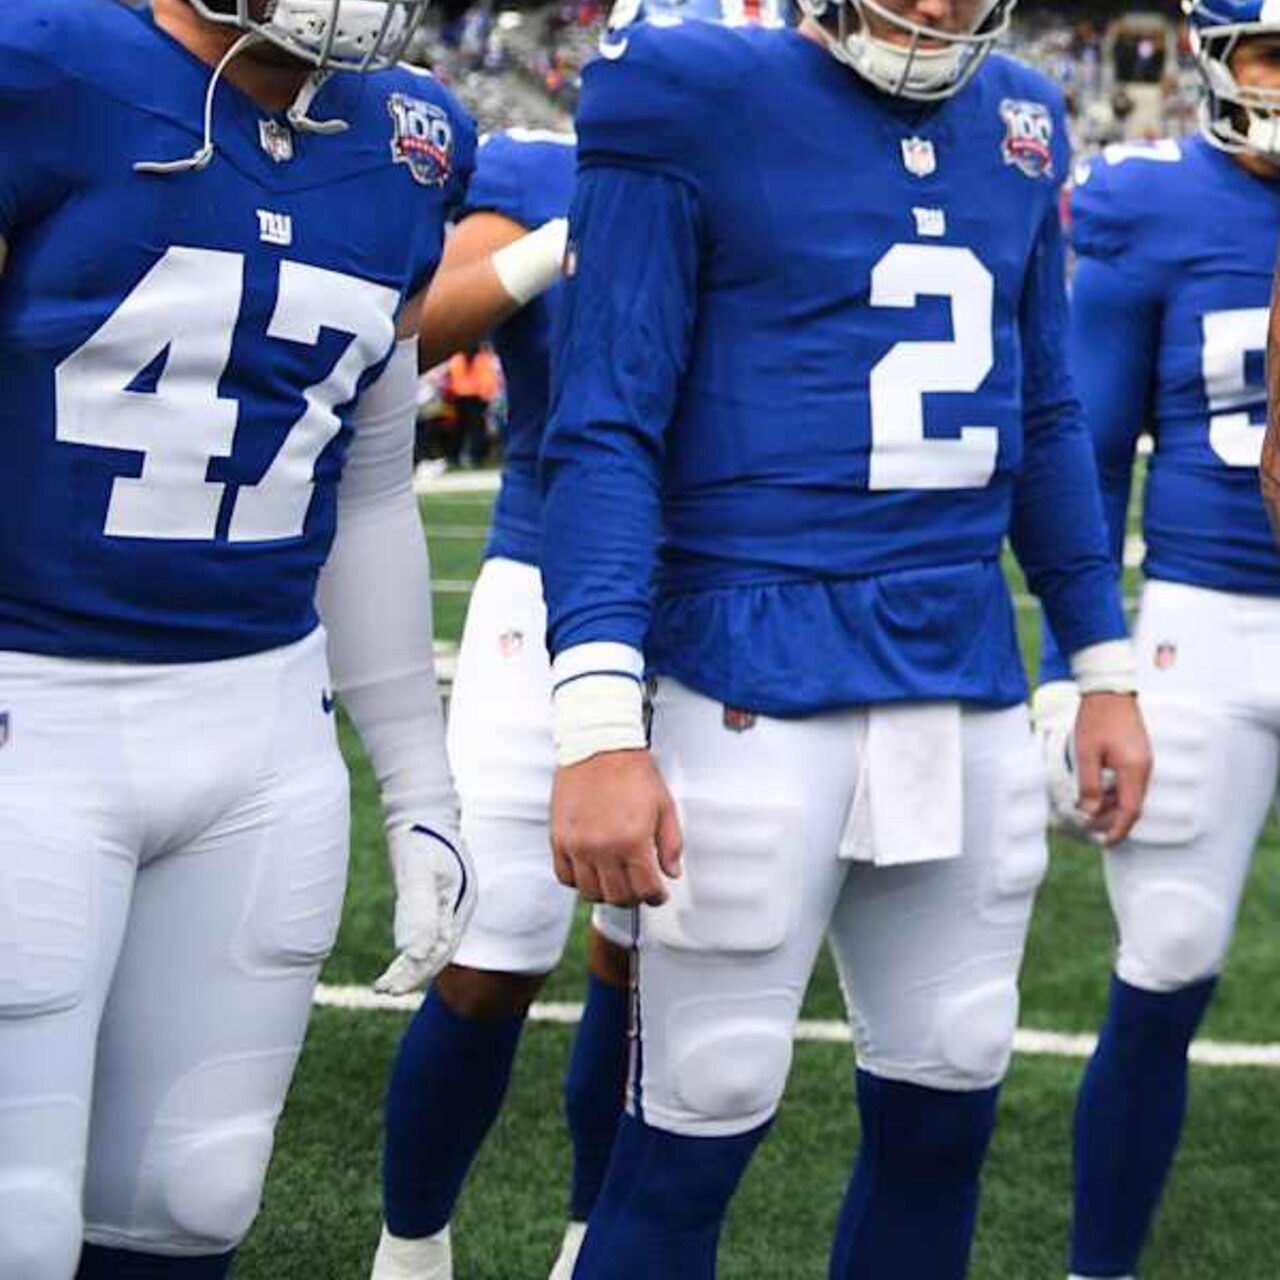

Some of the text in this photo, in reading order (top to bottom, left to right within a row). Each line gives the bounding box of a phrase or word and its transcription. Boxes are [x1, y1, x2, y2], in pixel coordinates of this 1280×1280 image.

[394, 102, 453, 153] 100
[55, 245, 401, 543] 47
[869, 243, 999, 490] 2
